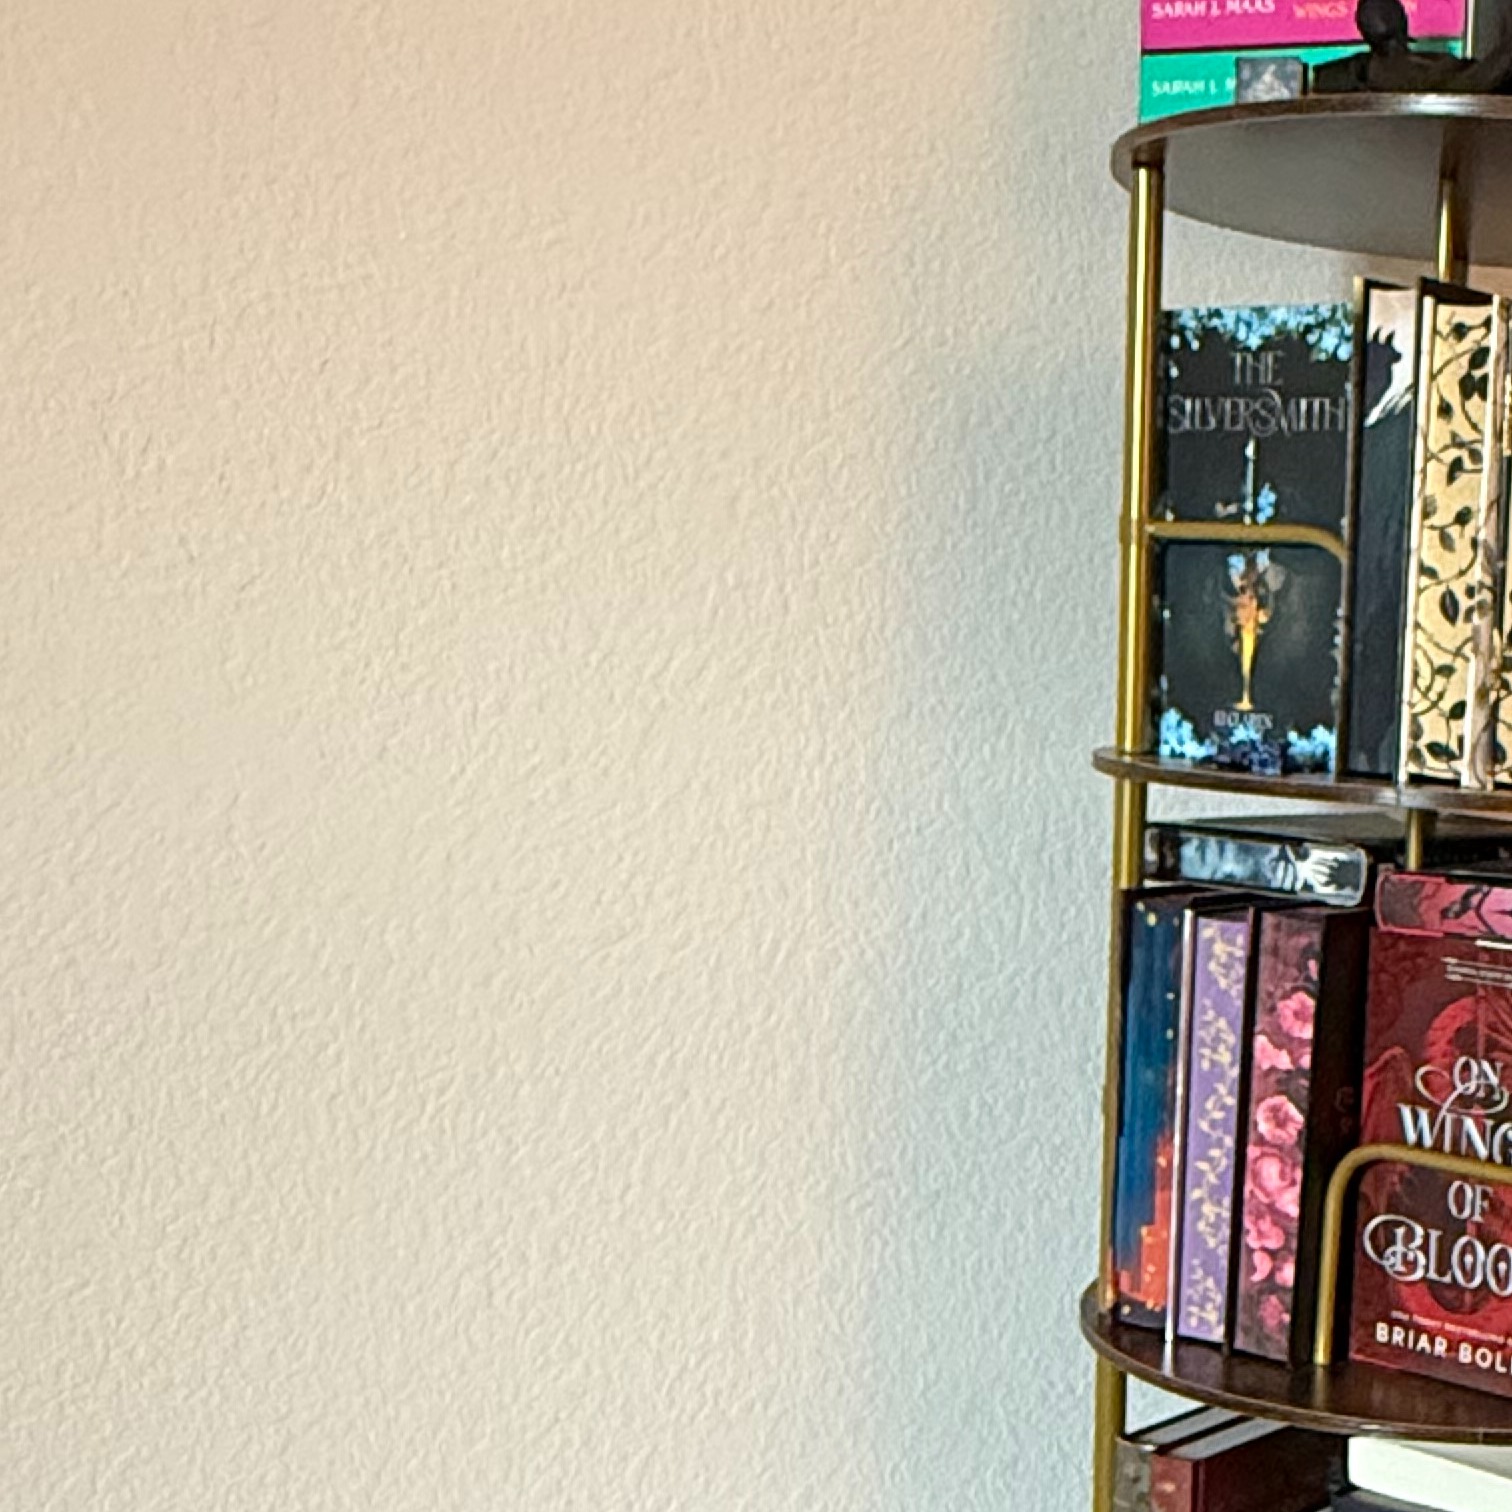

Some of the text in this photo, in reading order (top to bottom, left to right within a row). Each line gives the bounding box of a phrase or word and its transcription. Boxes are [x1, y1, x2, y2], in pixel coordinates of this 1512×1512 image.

[1231, 350, 1285, 385] THE
[1167, 388, 1347, 437] SILVERSMITH
[1447, 1180, 1493, 1223] OF
[1375, 1321, 1448, 1358] BRIAR
